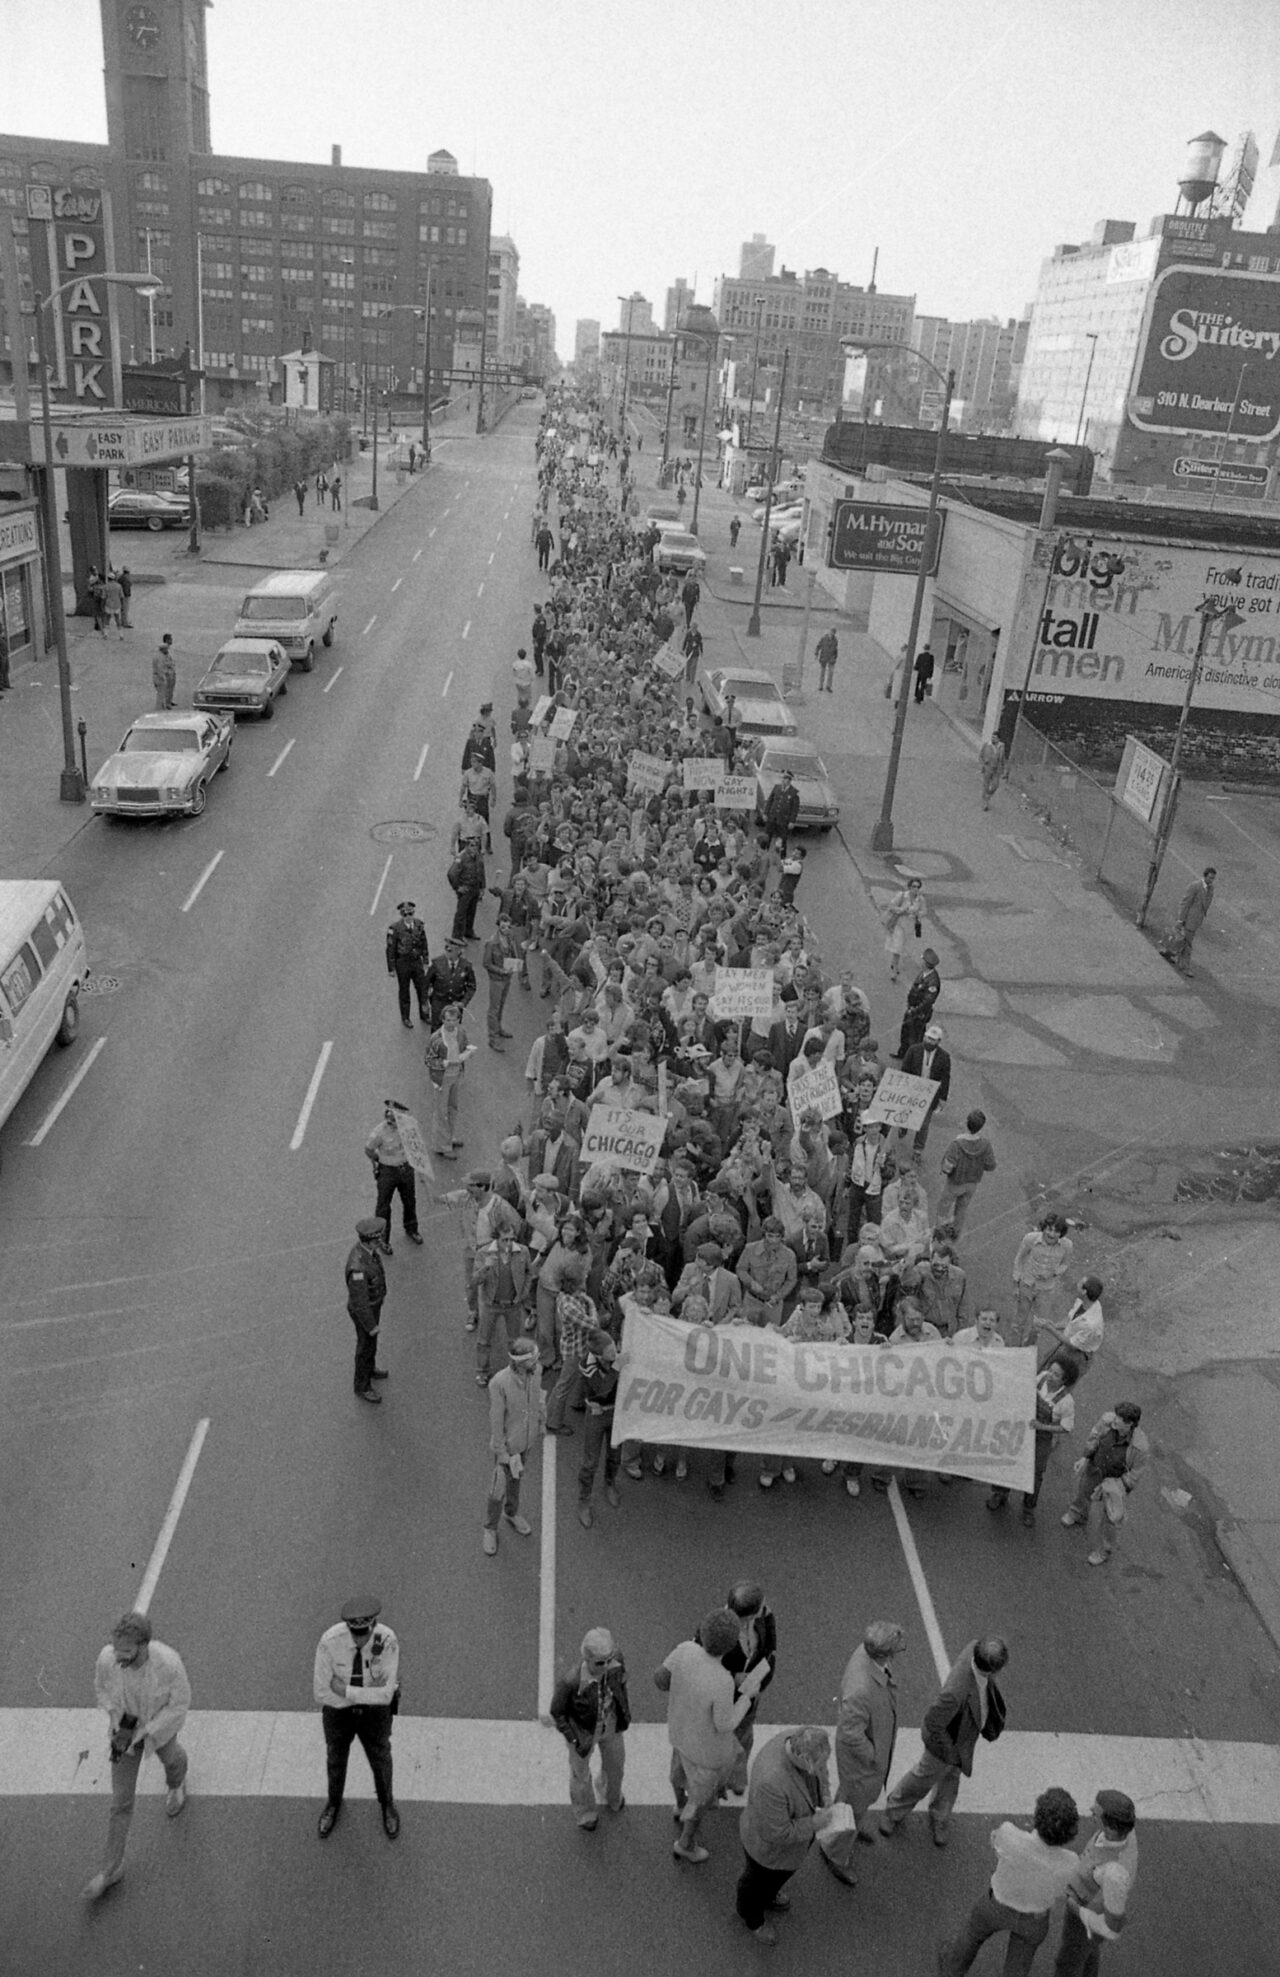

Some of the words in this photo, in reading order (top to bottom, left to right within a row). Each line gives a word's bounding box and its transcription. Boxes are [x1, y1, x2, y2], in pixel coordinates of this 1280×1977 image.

[53, 186, 102, 222] Easy
[64, 232, 107, 400] PARK
[1199, 313, 1225, 325] THE
[1160, 308, 1280, 360] Suitery
[1157, 391, 1177, 406] 310
[1191, 395, 1236, 413] Dearborn
[1240, 400, 1271, 417] Street
[98, 432, 123, 444] EASY
[100, 449, 125, 460] PARK
[844, 549, 857, 559] We
[875, 551, 889, 561] the
[877, 539, 896, 550] and
[1053, 533, 1122, 589] big
[1048, 578, 1140, 615] men
[1248, 597, 1273, 613] got
[1041, 609, 1099, 650] tall
[1035, 648, 1125, 682] men
[1205, 668, 1259, 687] distinctive
[723, 776, 744, 785] GAY
[879, 1090, 927, 1109] CHICAGO
[619, 1124, 646, 1137] OUR
[587, 1135, 655, 1159] CHICAGO
[683, 1328, 778, 1385] ONE
[795, 1347, 994, 1403] CHICAGO
[622, 1378, 686, 1416] FOR
[949, 1417, 1026, 1457] ALSO
